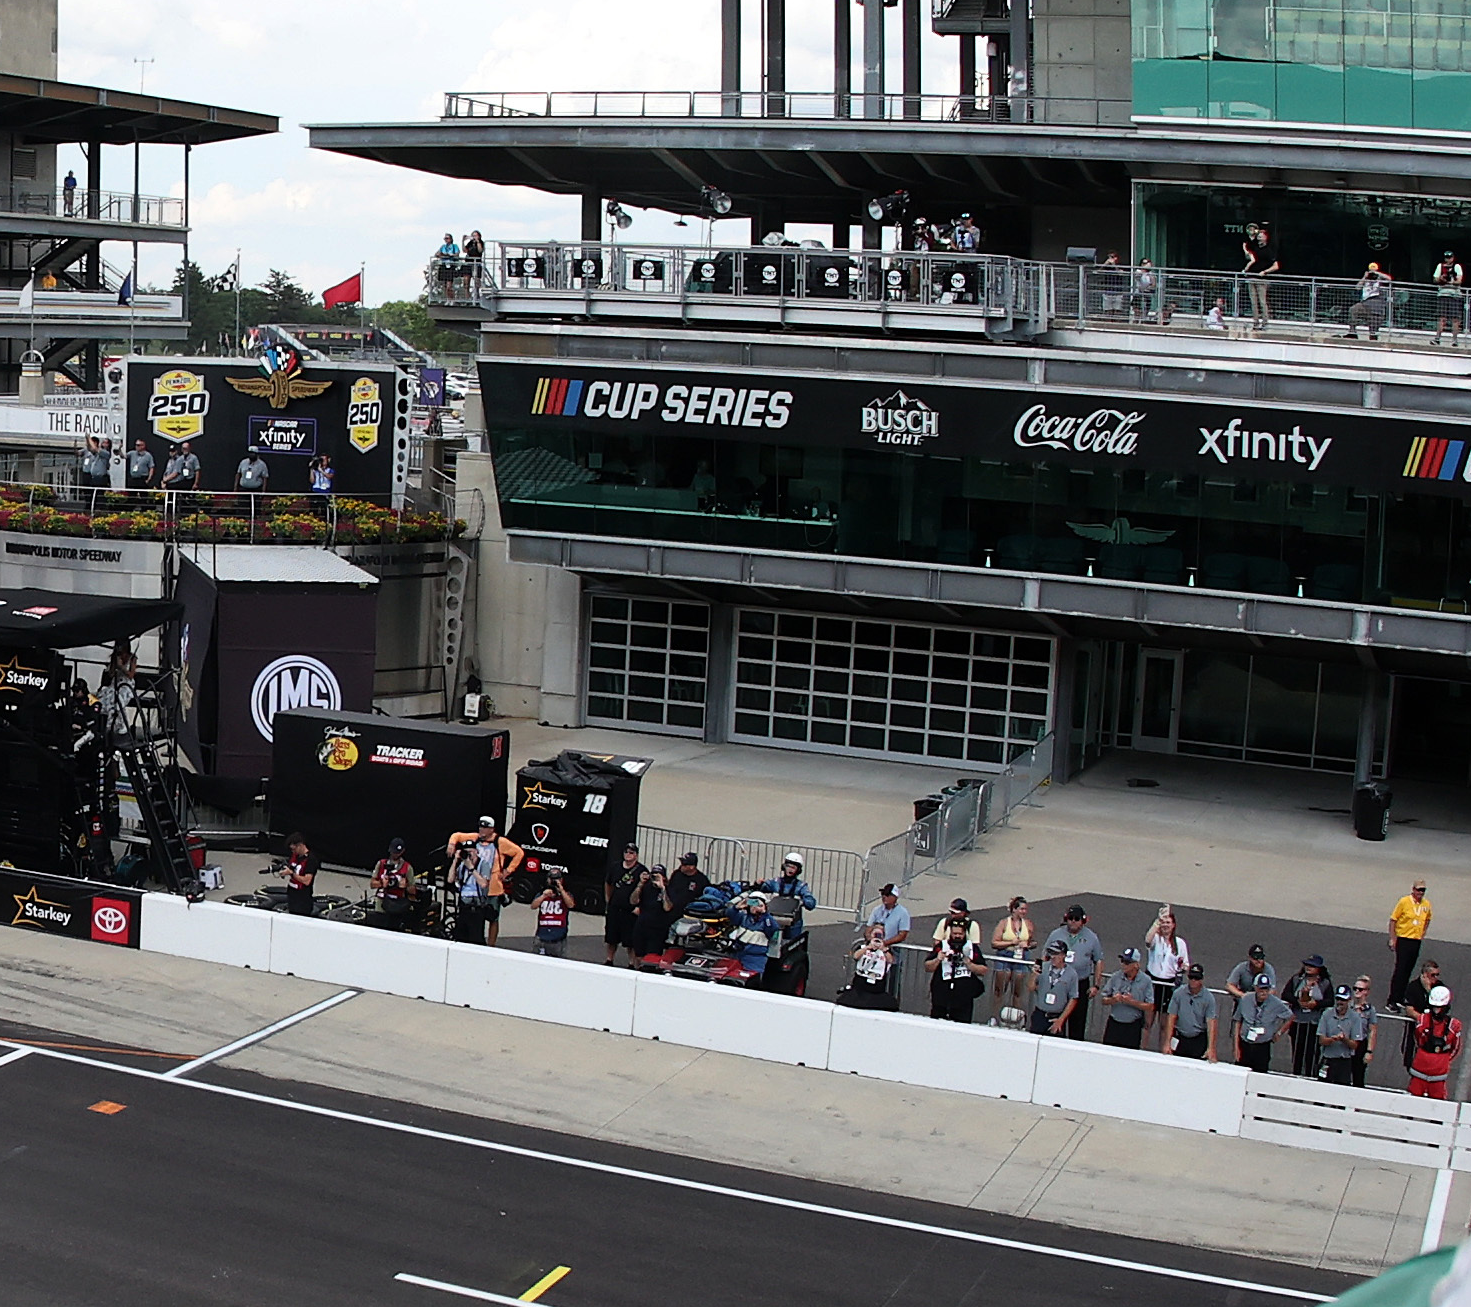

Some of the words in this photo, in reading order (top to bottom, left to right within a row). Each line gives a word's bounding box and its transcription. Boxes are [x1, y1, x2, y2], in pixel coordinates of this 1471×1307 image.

[152, 394, 206, 416] 250
[349, 403, 380, 425] 250
[584, 380, 658, 420] CUP
[661, 384, 793, 428] SERIES
[48, 412, 70, 432] THE
[861, 405, 940, 437] BUSCH
[1013, 403, 1146, 455] Coca-Cola
[259, 427, 305, 447] xfinity
[877, 432, 922, 446] LIGHT
[1198, 417, 1332, 471] xfinity
[7, 671, 48, 690] Starkey
[376, 745, 424, 759] TRACKER
[532, 793, 567, 808] Starkey
[582, 793, 607, 814] 18
[579, 836, 608, 848] JGR
[25, 902, 71, 926] Starkey
